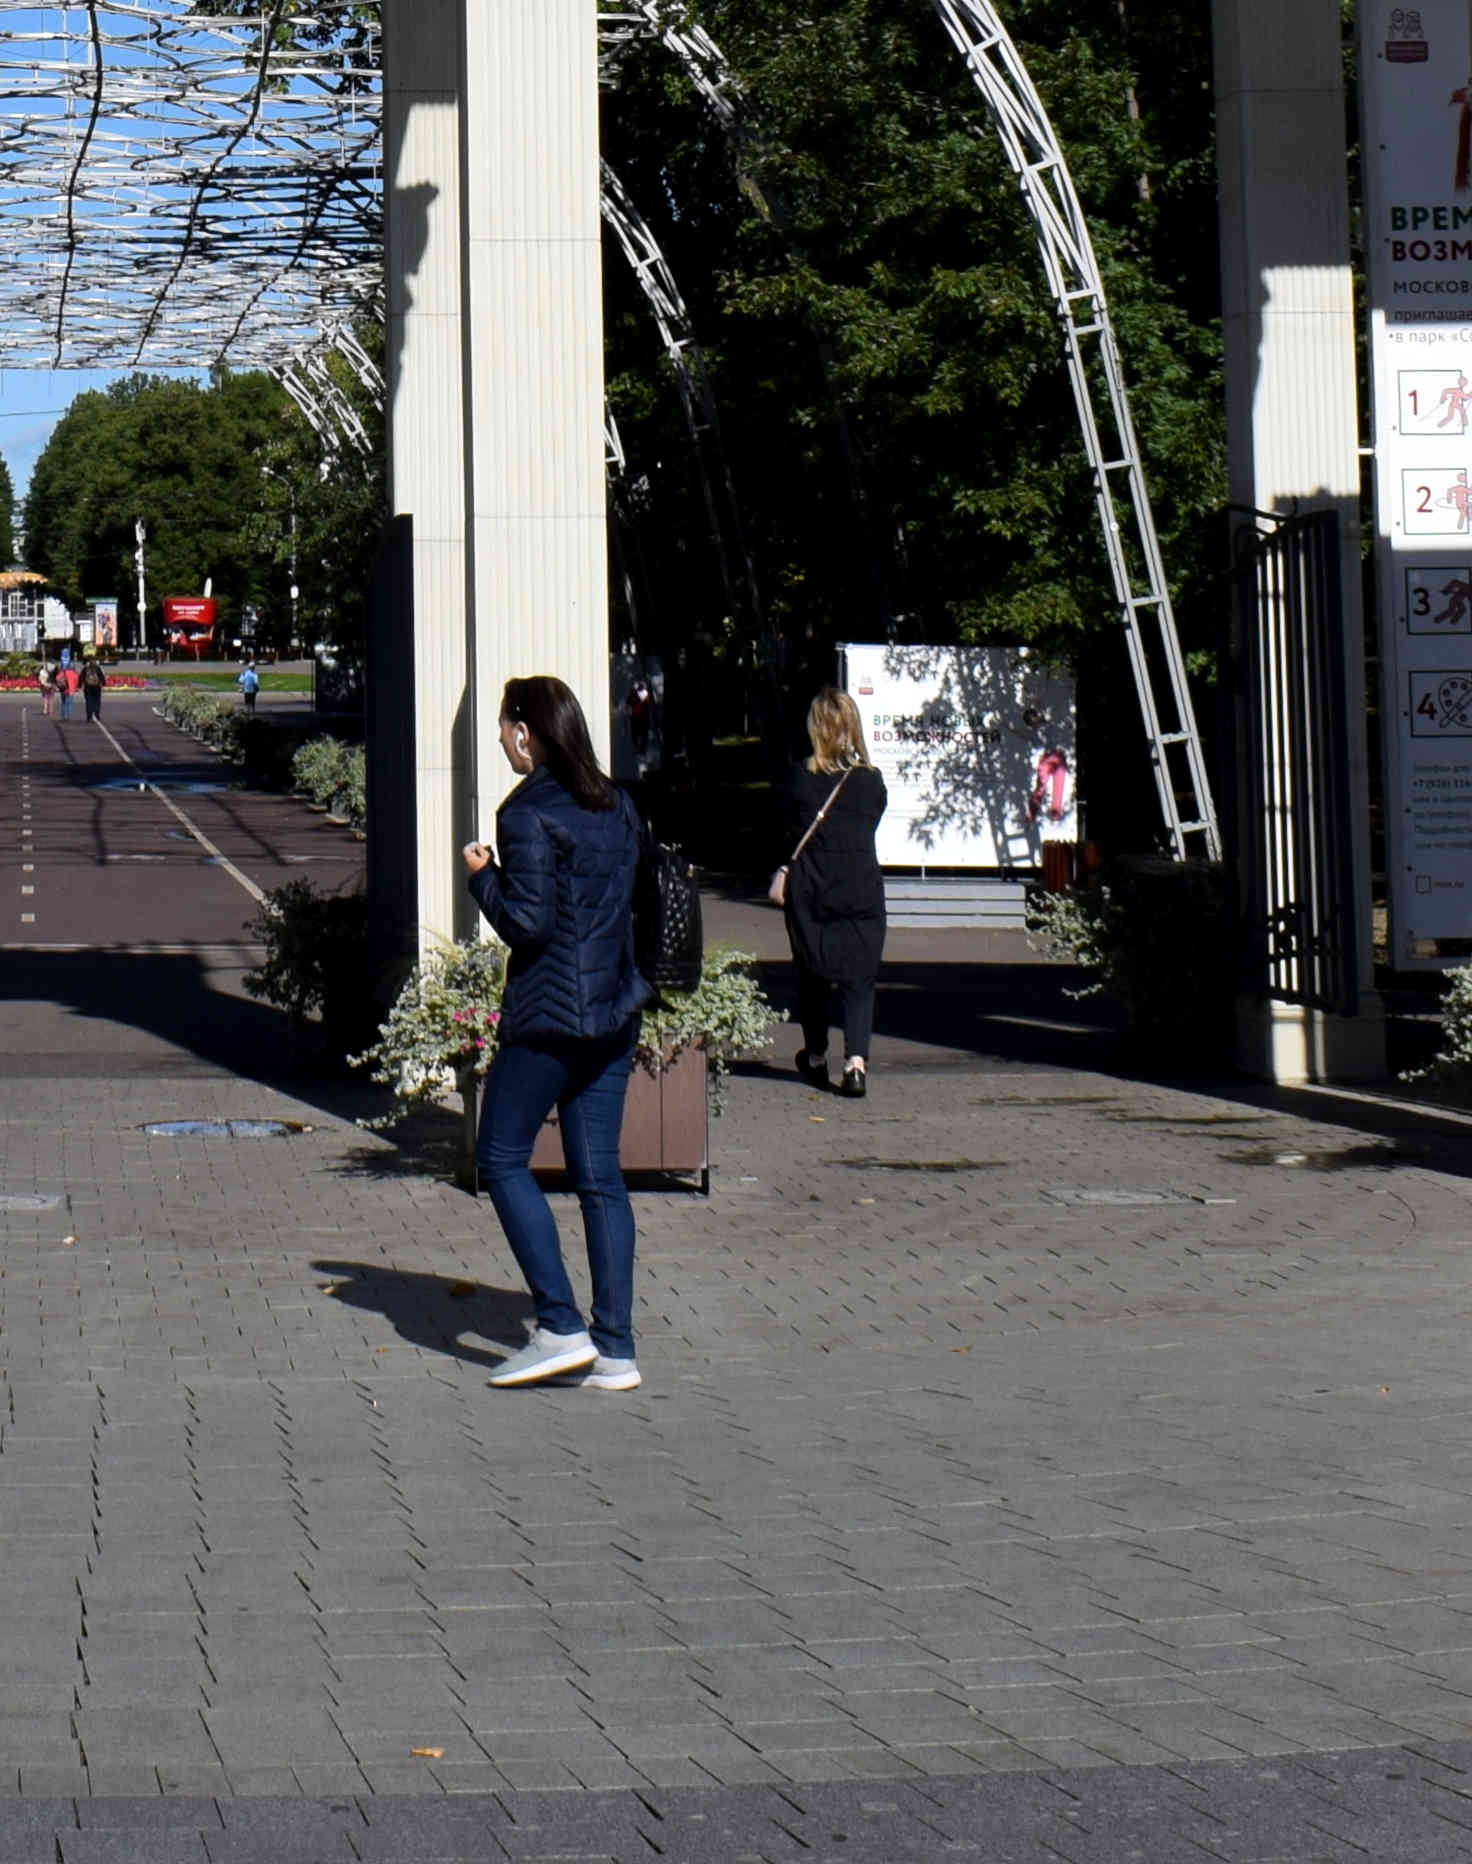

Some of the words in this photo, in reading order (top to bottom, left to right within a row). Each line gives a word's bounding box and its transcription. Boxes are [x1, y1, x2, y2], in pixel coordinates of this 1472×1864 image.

[1416, 486, 1432, 513] 2
[1413, 589, 1431, 616] 3
[1416, 692, 1436, 720] 4
